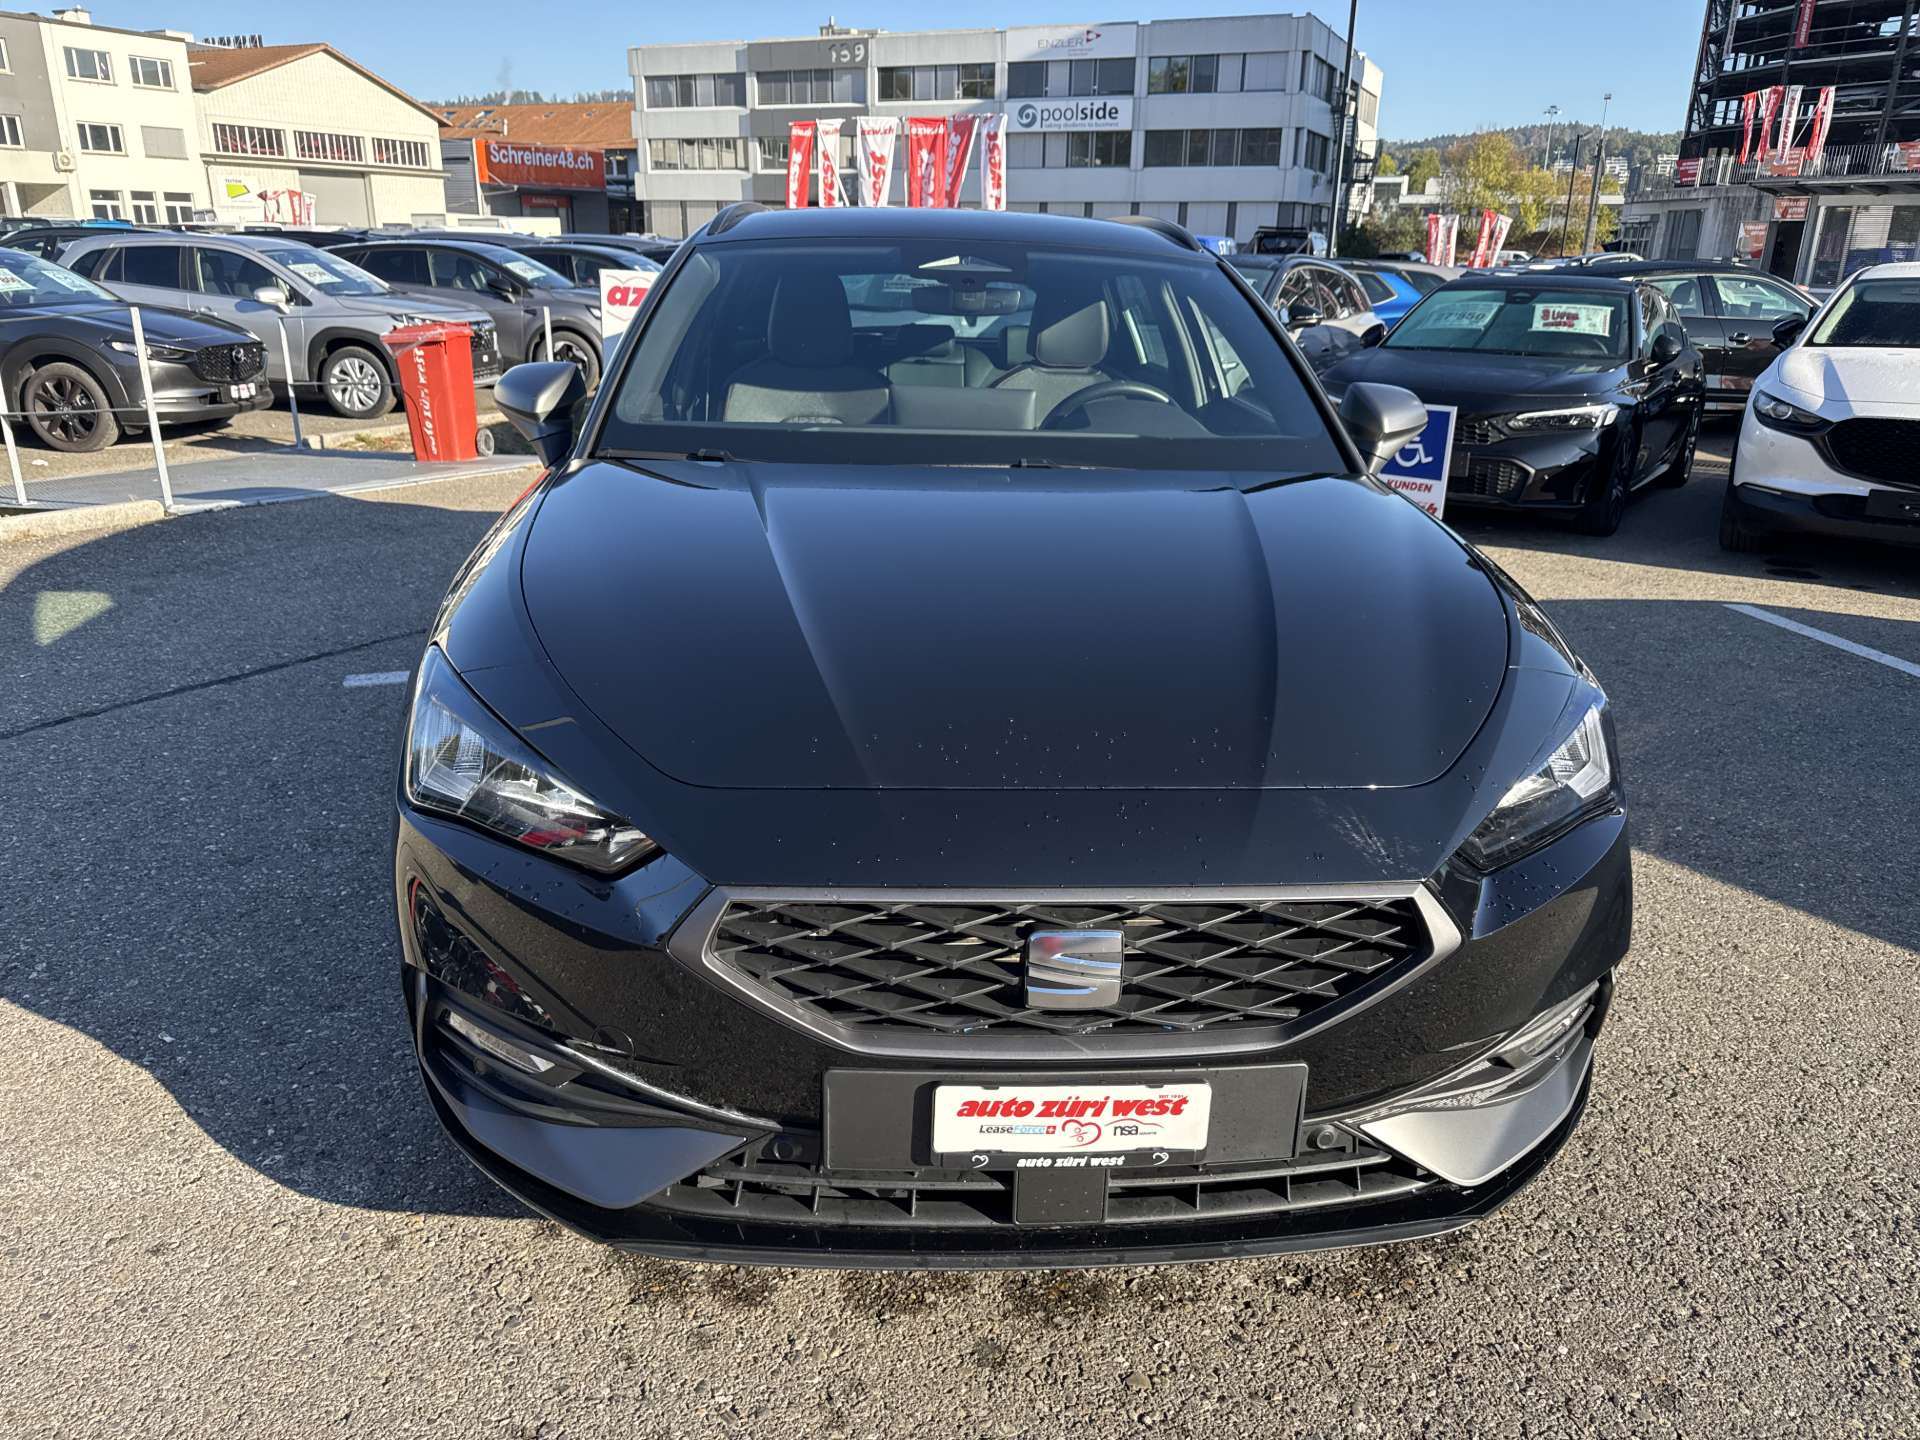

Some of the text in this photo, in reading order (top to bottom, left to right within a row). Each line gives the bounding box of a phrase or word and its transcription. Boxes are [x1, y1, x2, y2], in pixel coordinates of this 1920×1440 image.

[1038, 38, 1084, 49] ENZLER
[1040, 101, 1119, 129] poolside
[490, 144, 594, 170] Schreiner48.ch
[1387, 479, 1433, 493] KUNDEN
[956, 1096, 1189, 1117] auto züri west
[979, 1124, 1045, 1135] LeaseForce
[1113, 1125, 1139, 1136] nsa
[1016, 1154, 1126, 1168] auto züri west
